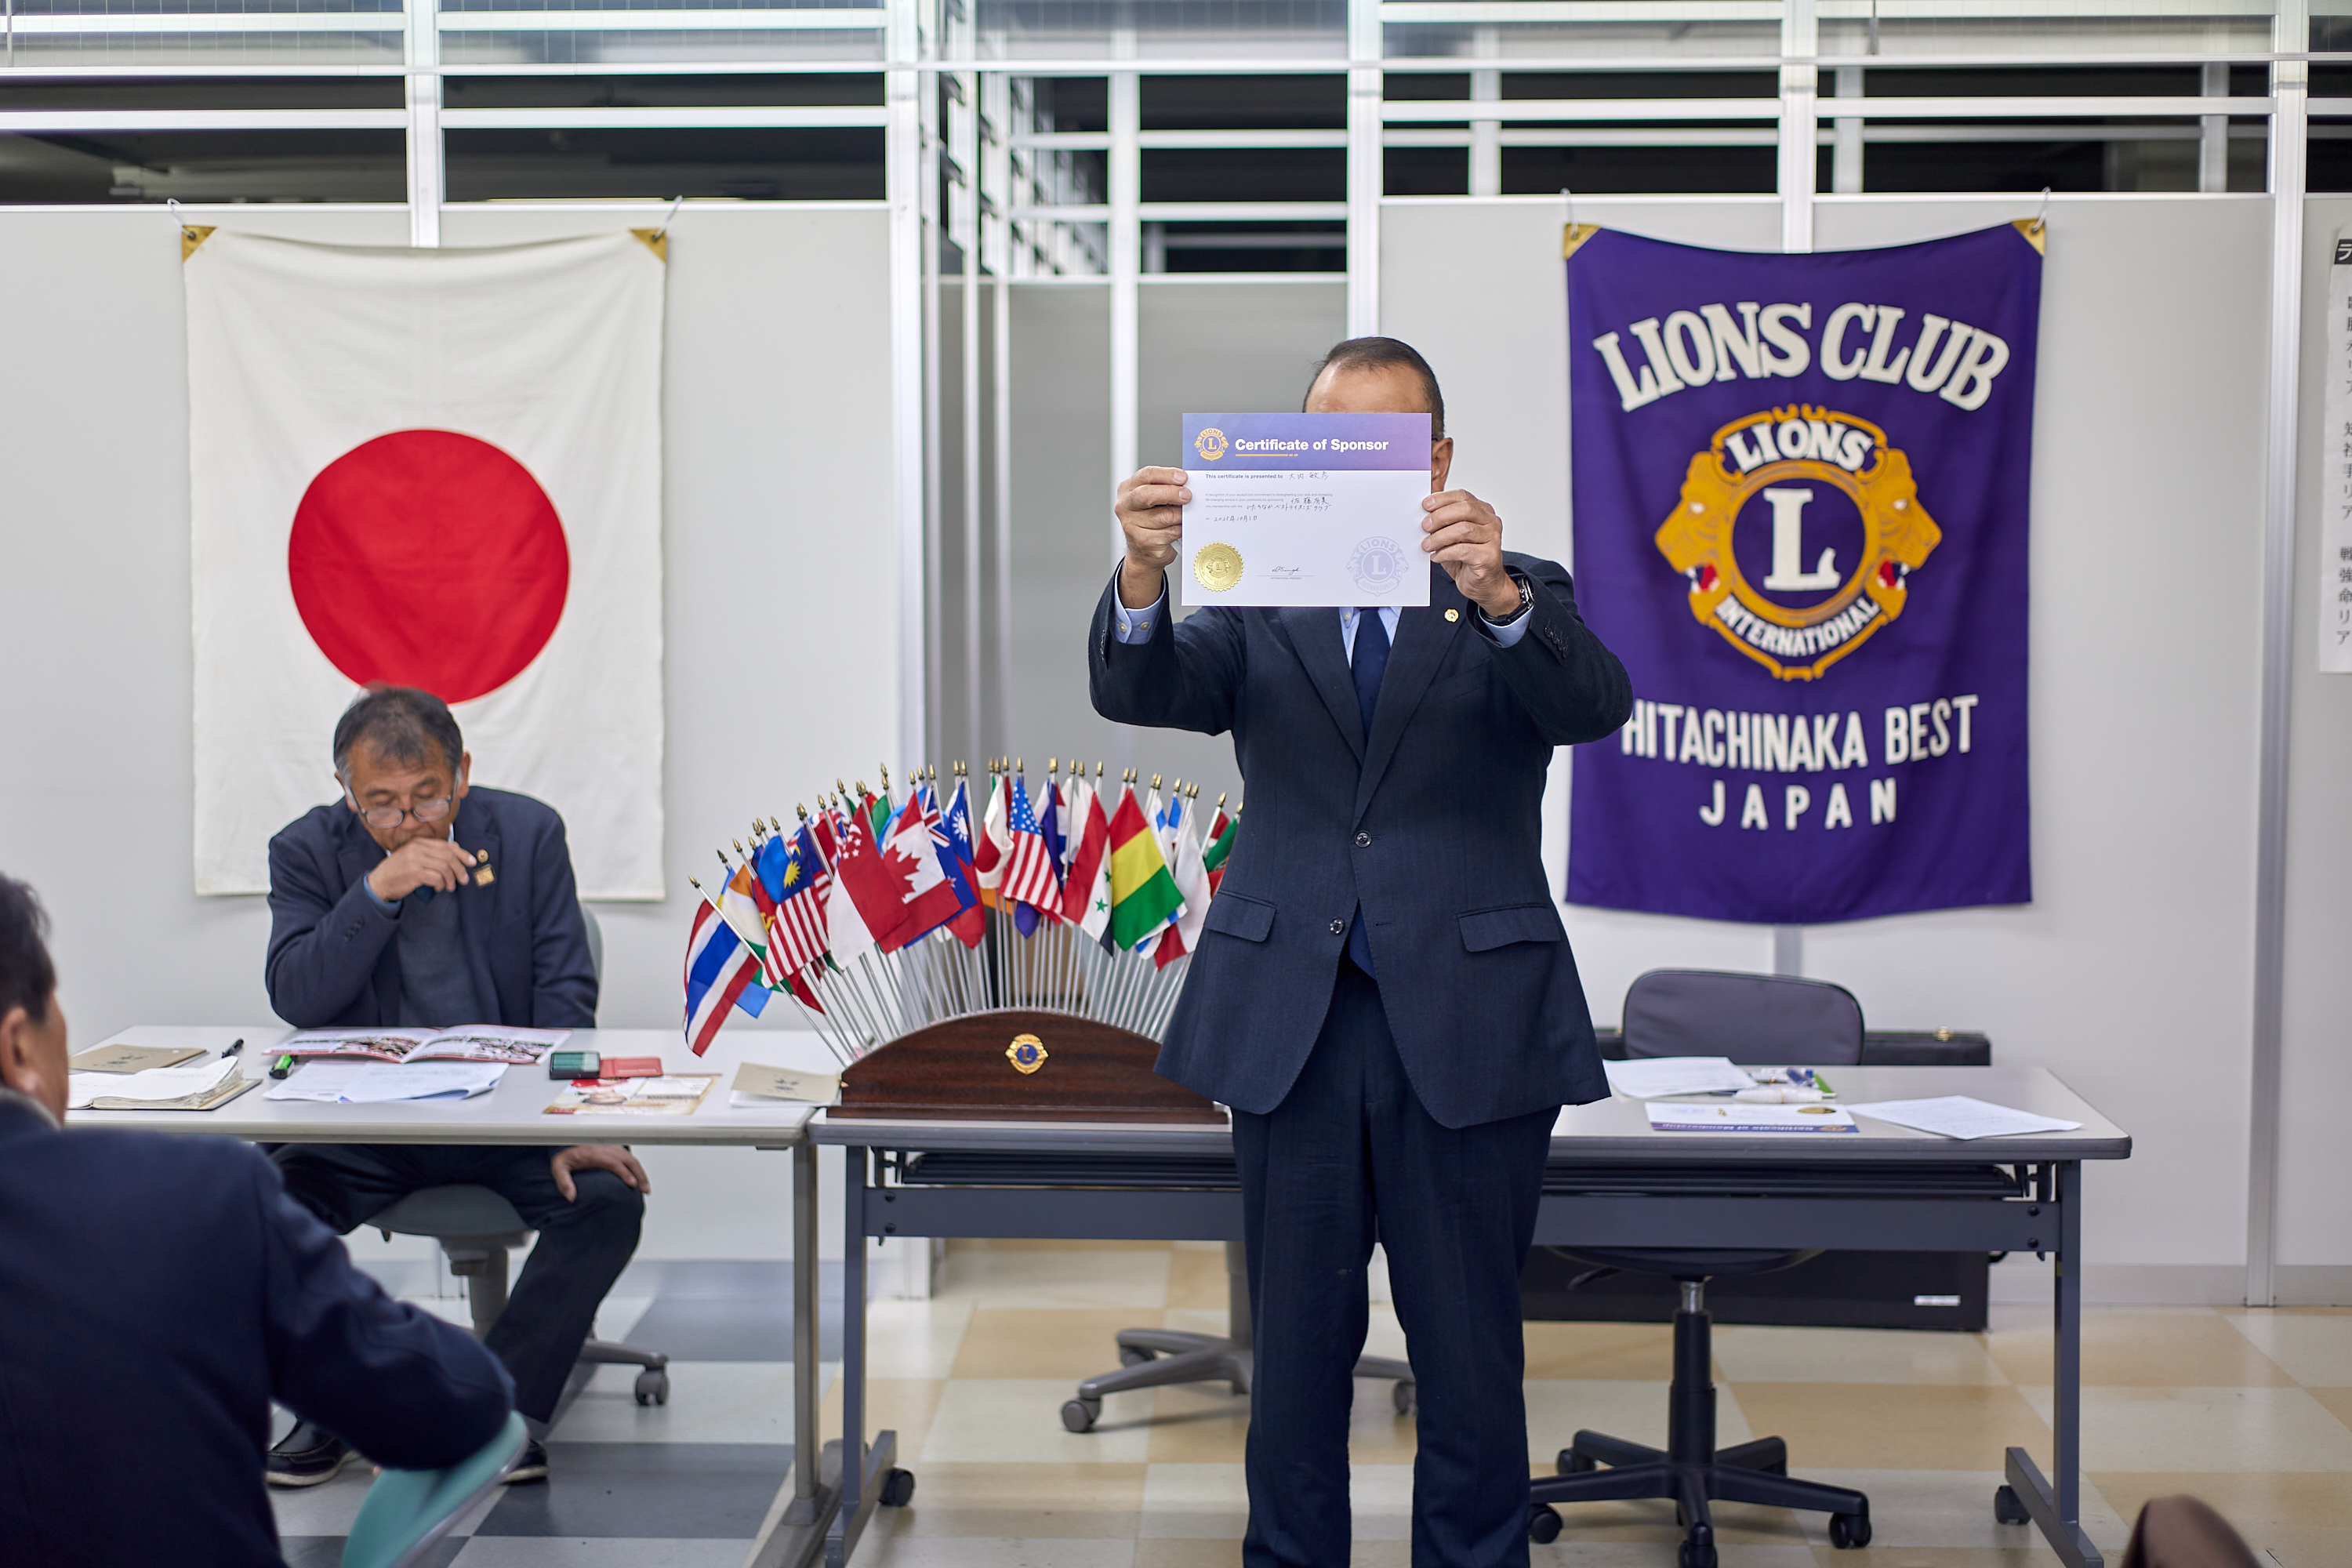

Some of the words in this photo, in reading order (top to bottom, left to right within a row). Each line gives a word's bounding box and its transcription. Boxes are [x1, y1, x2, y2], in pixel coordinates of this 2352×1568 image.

[1593, 301, 1812, 412] LIONS
[1820, 302, 2010, 412] CLUB
[1208, 437, 1217, 449] L
[1235, 438, 1308, 450] Certificate
[1312, 438, 1327, 450] of
[1330, 438, 1388, 452] Sponsor
[1725, 418, 1875, 474] LIONS
[1360, 539, 1396, 552] LIONS
[1763, 487, 1842, 591] L
[1371, 555, 1387, 575] L
[1360, 580, 1395, 592] INTERNATIONAL
[1715, 593, 1882, 657] INTERNATIONAL
[1621, 698, 1868, 773] HITACHINAKA
[1885, 693, 1979, 766] BEST
[1699, 776, 1897, 831] JAPAN
[1022, 1046, 1033, 1062] L
